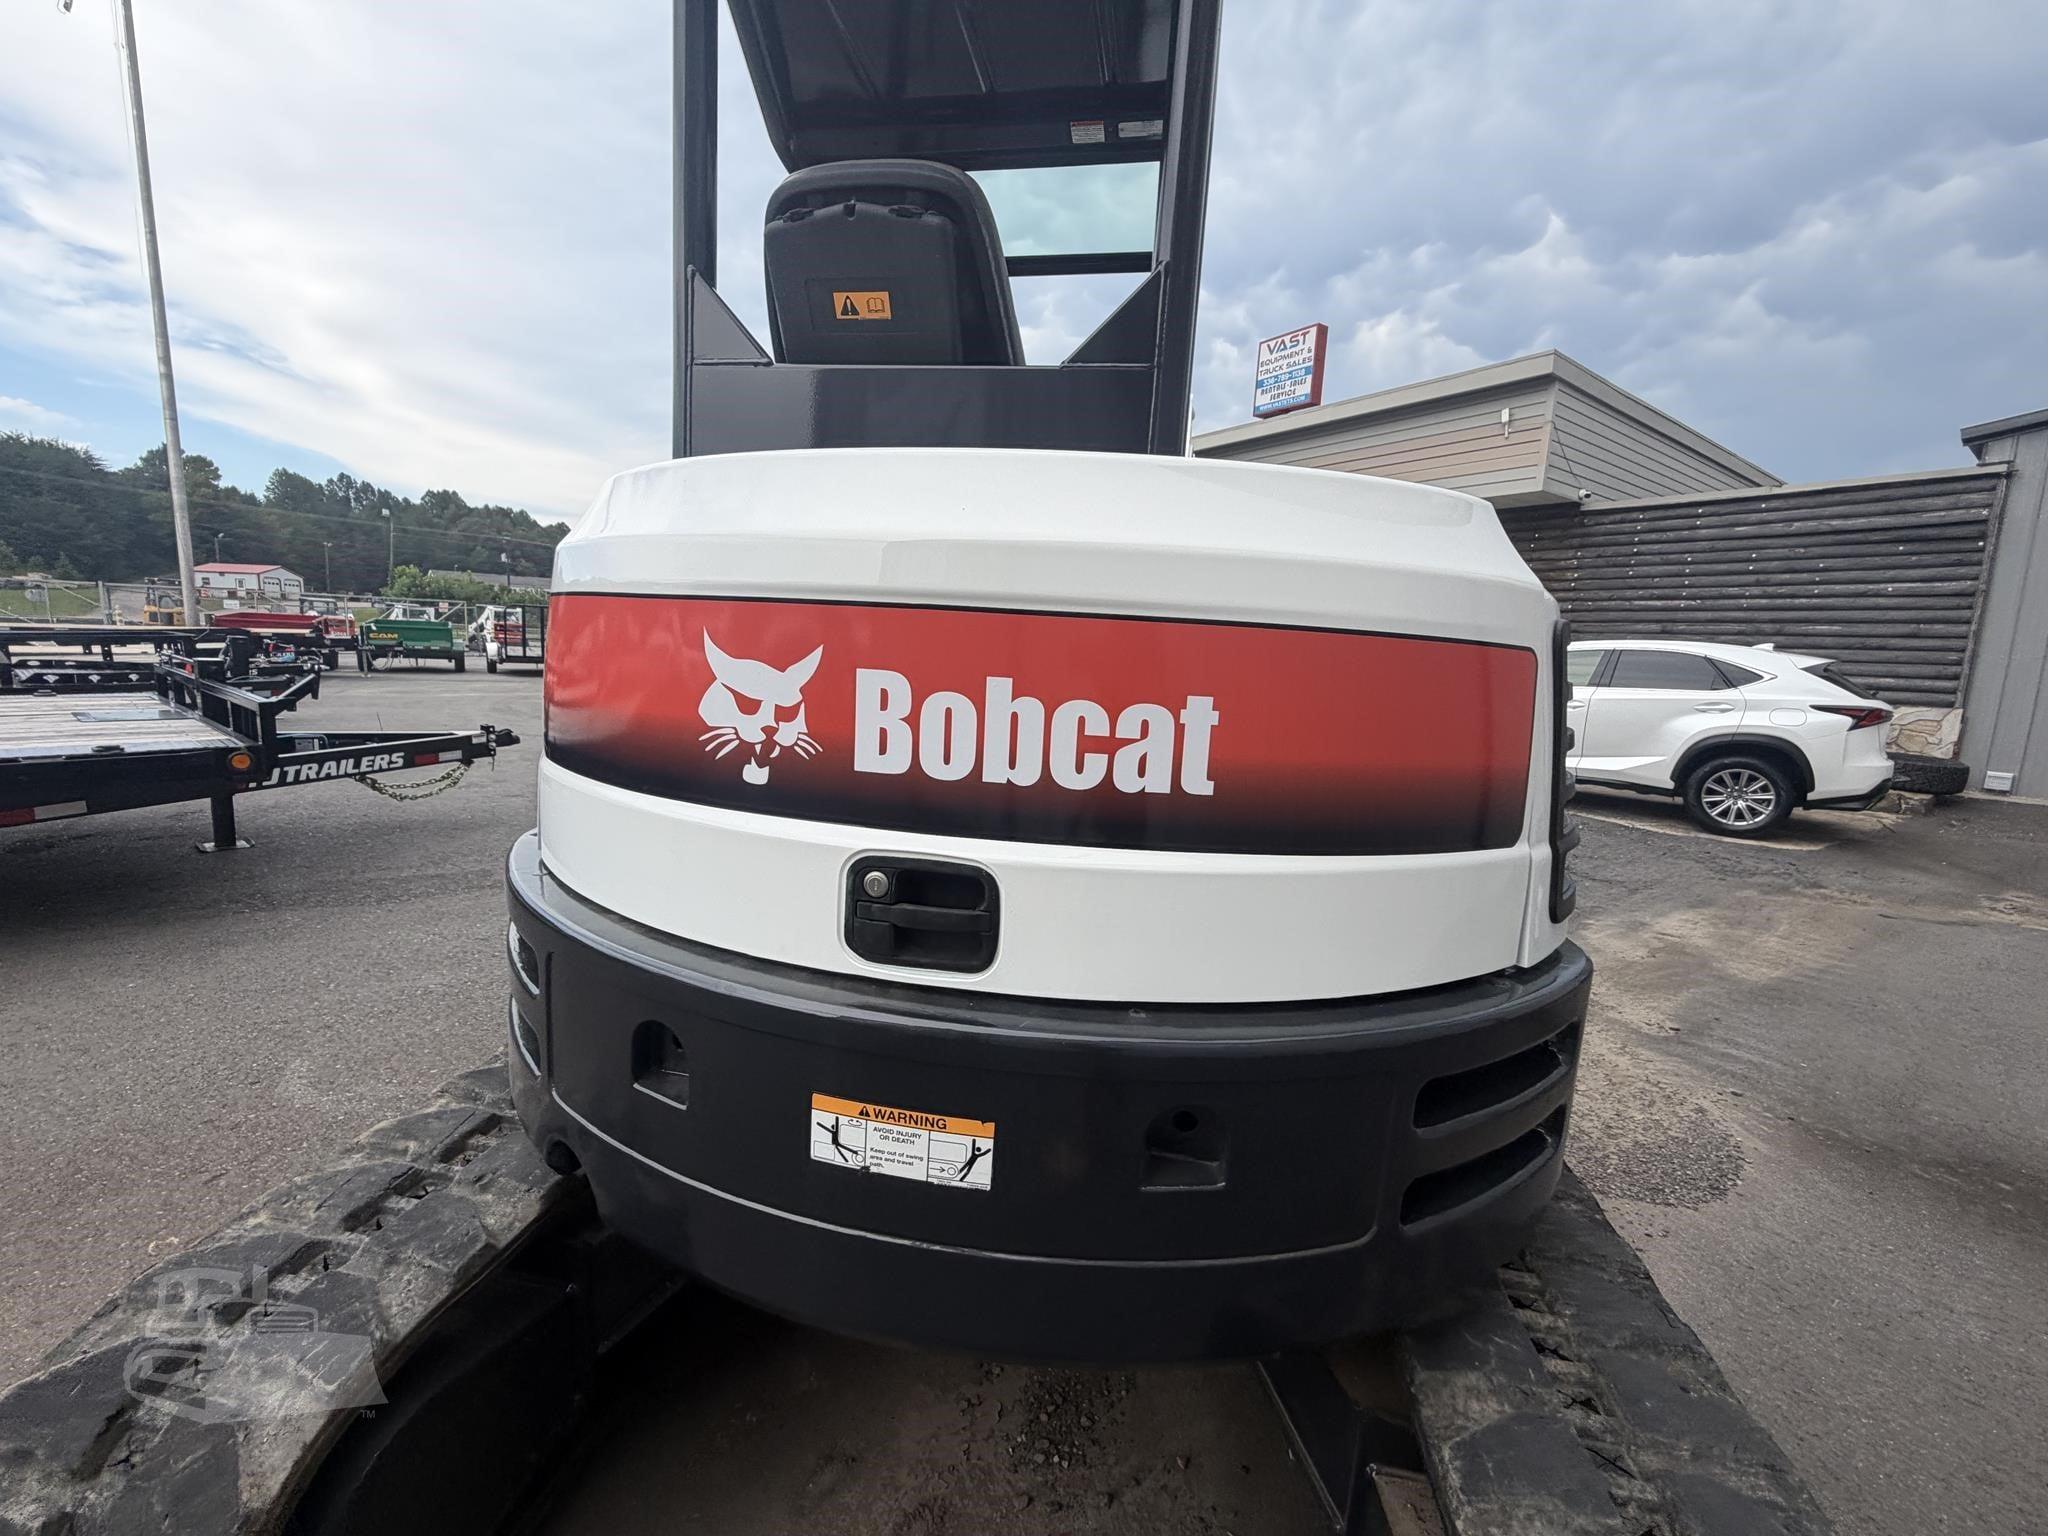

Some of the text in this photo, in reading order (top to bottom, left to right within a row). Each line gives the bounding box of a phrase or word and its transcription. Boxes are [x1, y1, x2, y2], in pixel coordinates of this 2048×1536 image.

[1267, 331, 1310, 355] VAST
[1259, 356, 1313, 377] TRUCK SALES
[1260, 349, 1305, 367] EQUIPMENT
[1269, 388, 1297, 402] SERVICE
[854, 667, 1220, 795] Bobcat
[283, 752, 405, 783] TRAILERS
[873, 1108, 947, 1130] WARNING
[873, 1126, 922, 1140] AVOID INJURY
[879, 1134, 915, 1146] OR DEATH
[906, 1154, 924, 1162] swing
